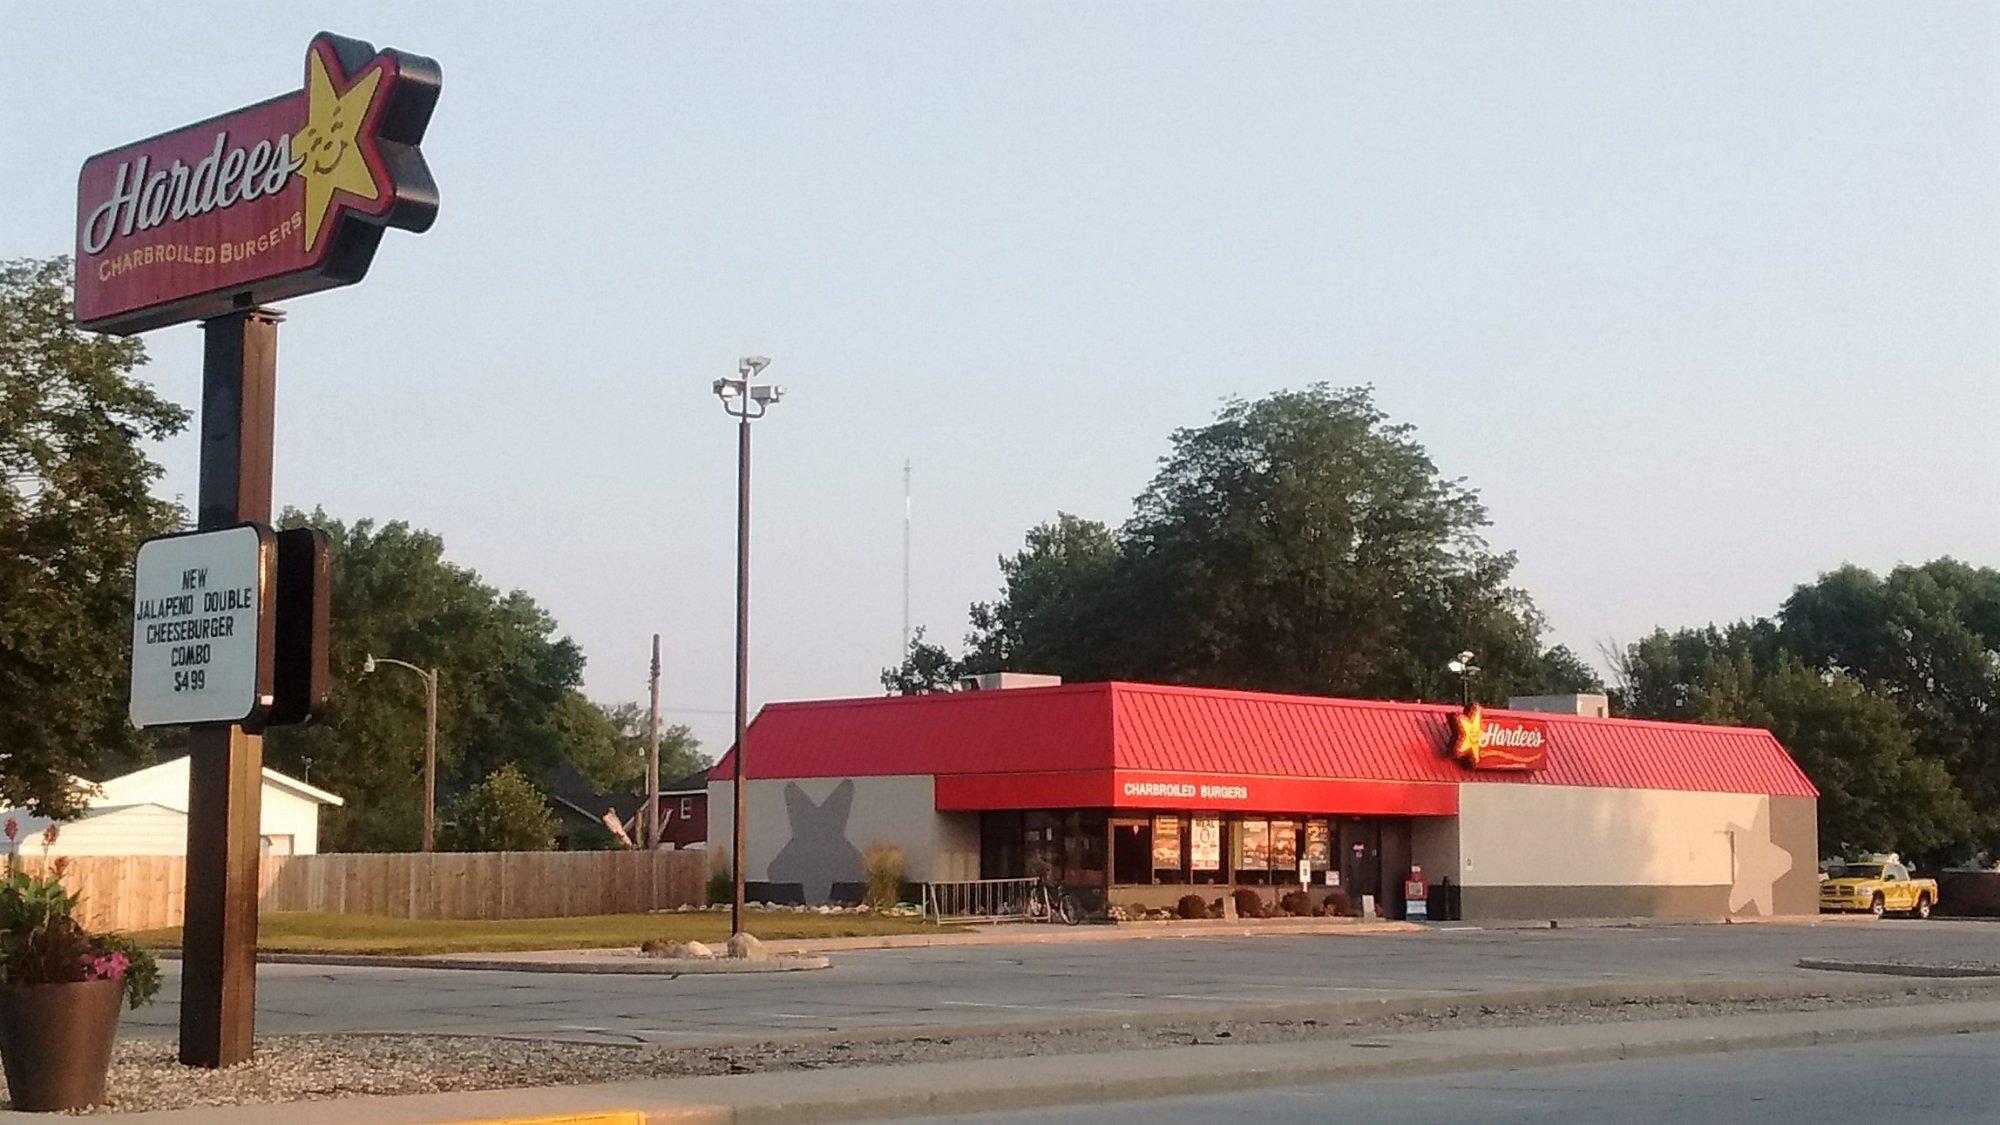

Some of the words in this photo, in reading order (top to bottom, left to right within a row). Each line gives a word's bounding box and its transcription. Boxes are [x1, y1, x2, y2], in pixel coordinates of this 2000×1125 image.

[99, 244, 216, 282] CHARBROILED
[220, 211, 303, 264] BURGERS
[182, 568, 208, 590] NEW
[137, 594, 194, 620] JALAPENO
[203, 587, 252, 613] DOUBLE
[146, 615, 234, 645] CHEESEBURGER
[171, 643, 211, 667] COMBO
[1123, 782, 1197, 798] CHARBROILED
[1200, 785, 1248, 800] BURGERS
